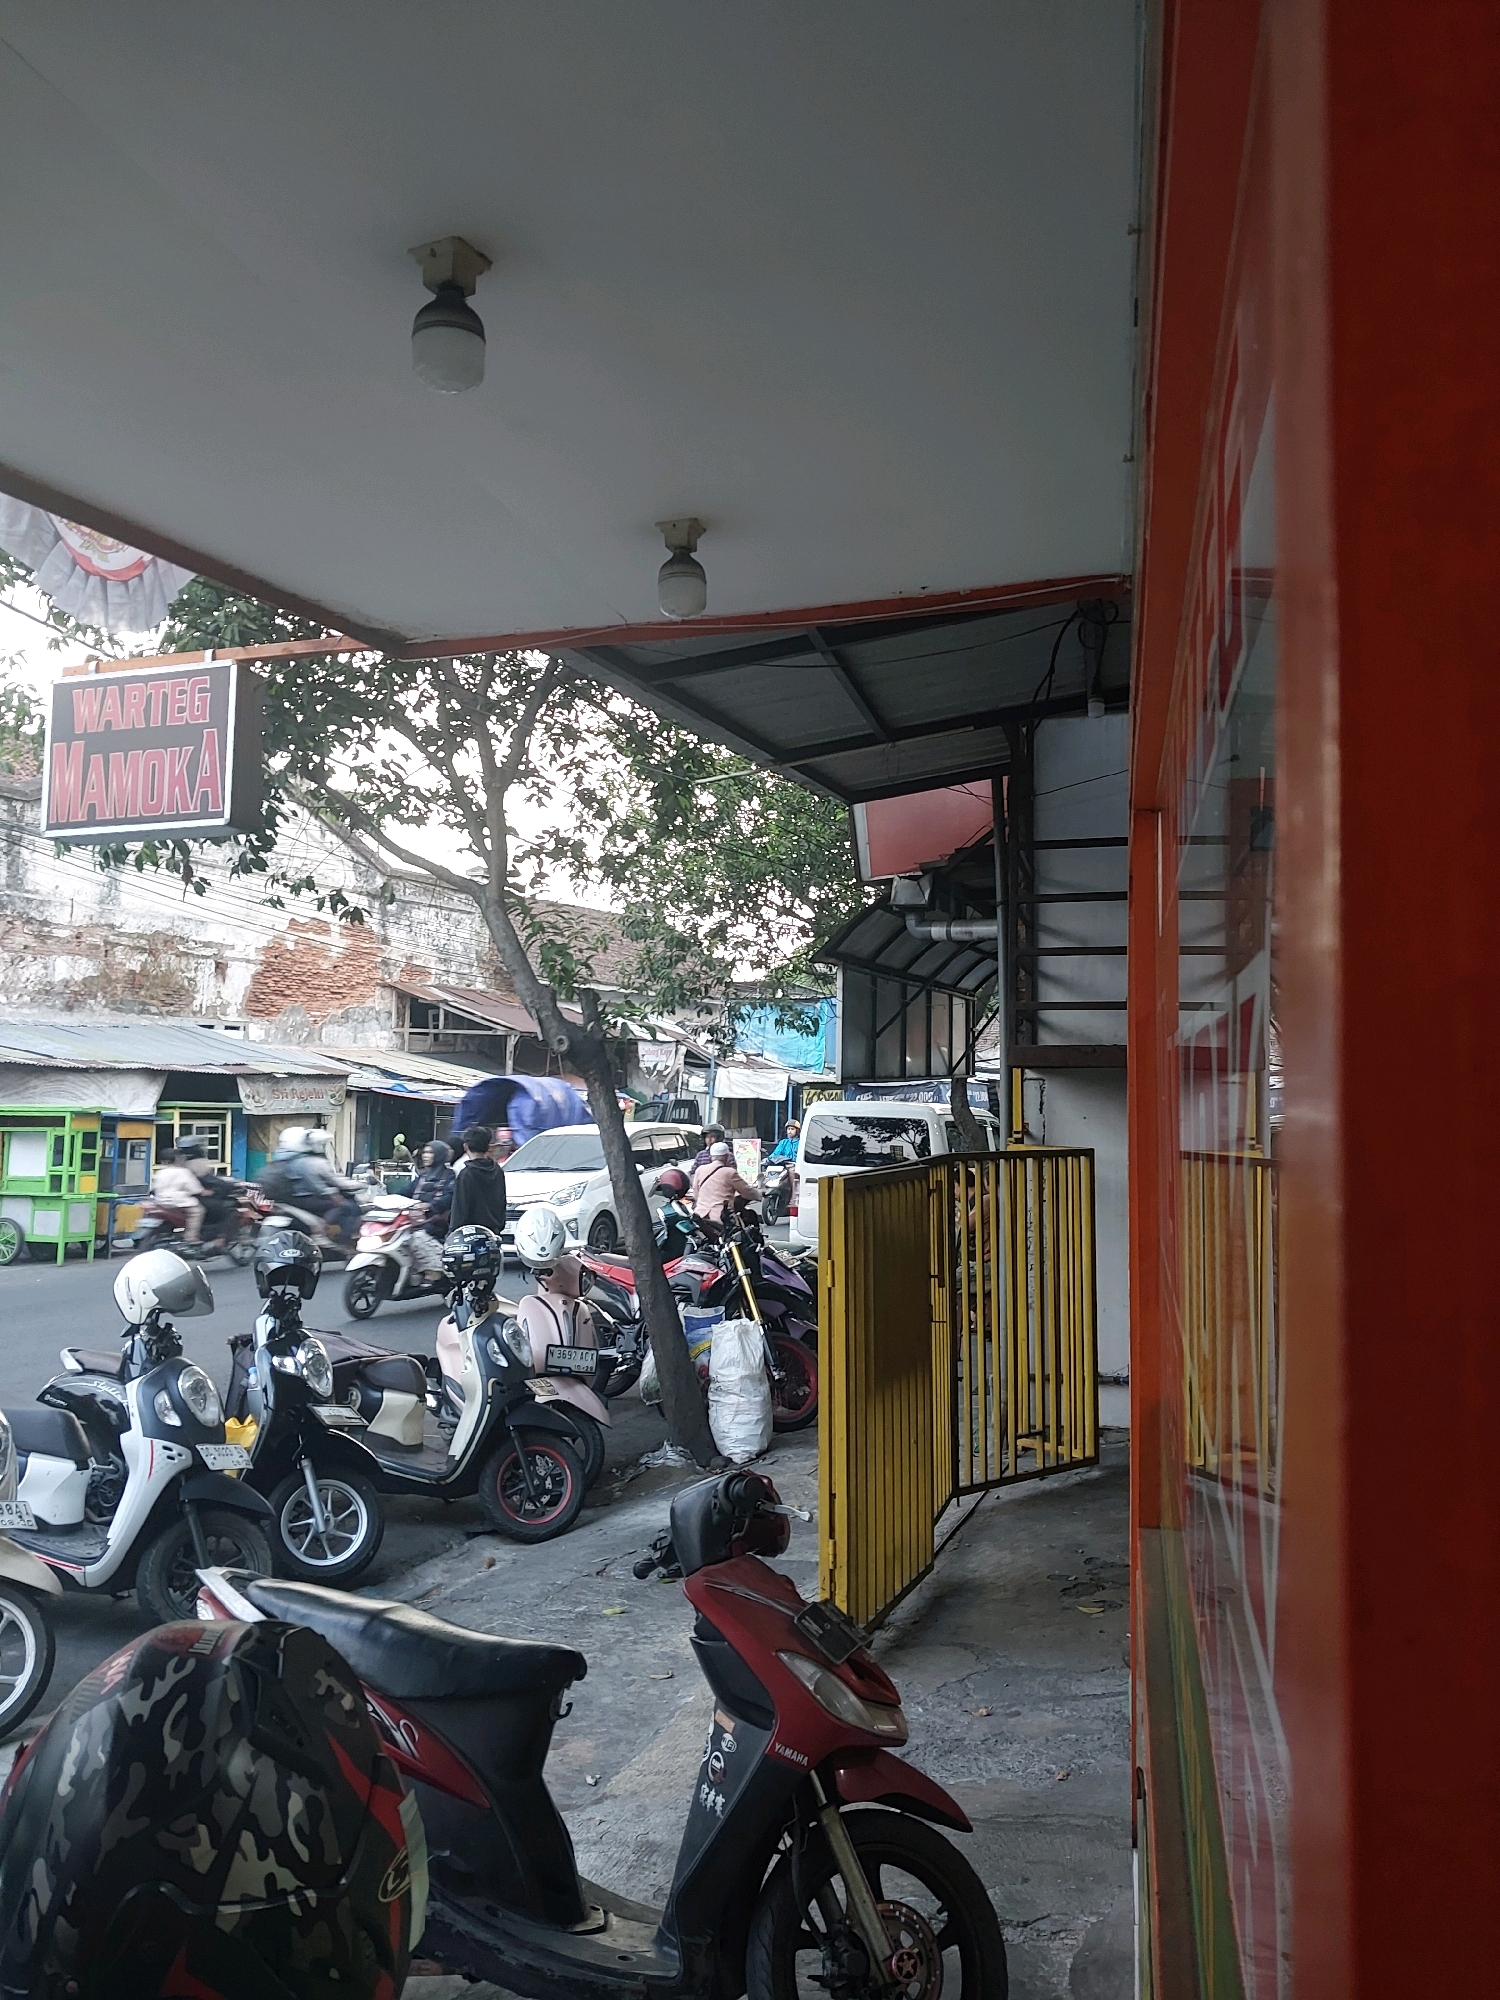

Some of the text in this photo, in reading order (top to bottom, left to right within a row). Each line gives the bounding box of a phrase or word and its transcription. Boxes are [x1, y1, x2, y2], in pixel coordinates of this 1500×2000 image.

[72, 676, 211, 734] WARTEG
[49, 728, 223, 823] MAMOKA
[271, 1088, 325, 1102] Sri Rejeki
[557, 1349, 577, 1360] 3692
[774, 1742, 810, 1767] YAMAHA
